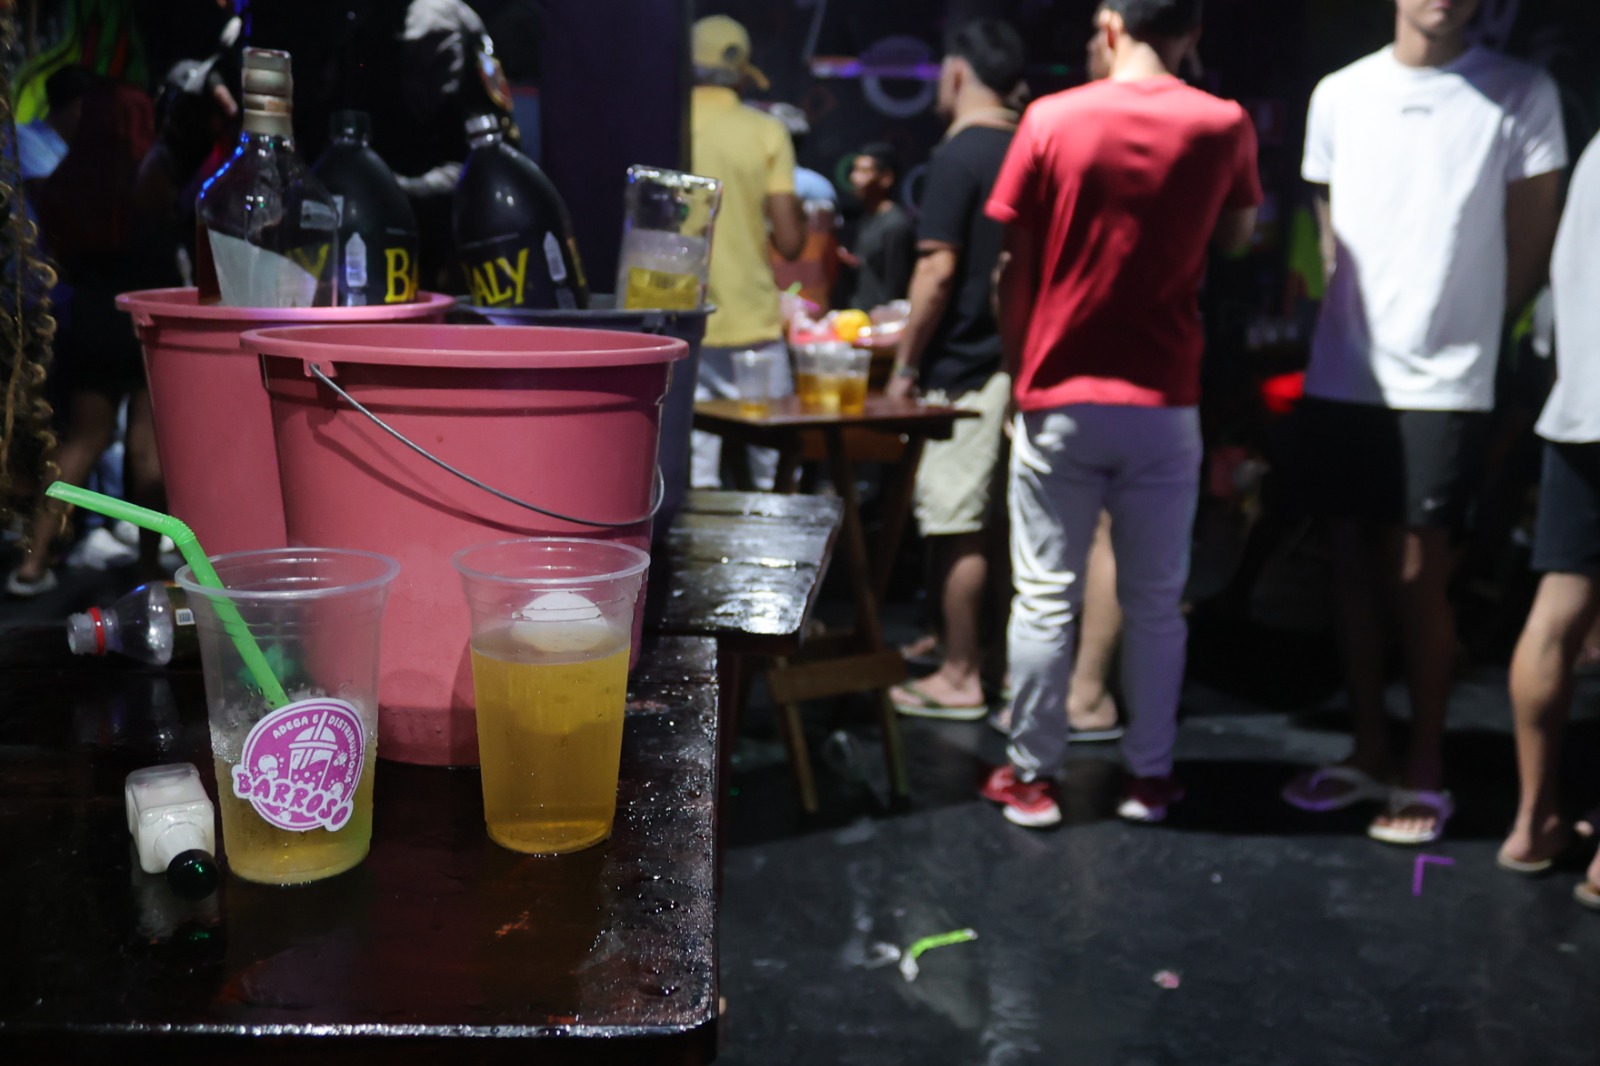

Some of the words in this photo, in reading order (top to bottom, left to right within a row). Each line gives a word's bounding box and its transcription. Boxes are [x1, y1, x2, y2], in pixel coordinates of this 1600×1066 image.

[461, 248, 529, 306] ALY
[272, 715, 309, 740] ADEGA
[236, 772, 350, 826] BARROSO
